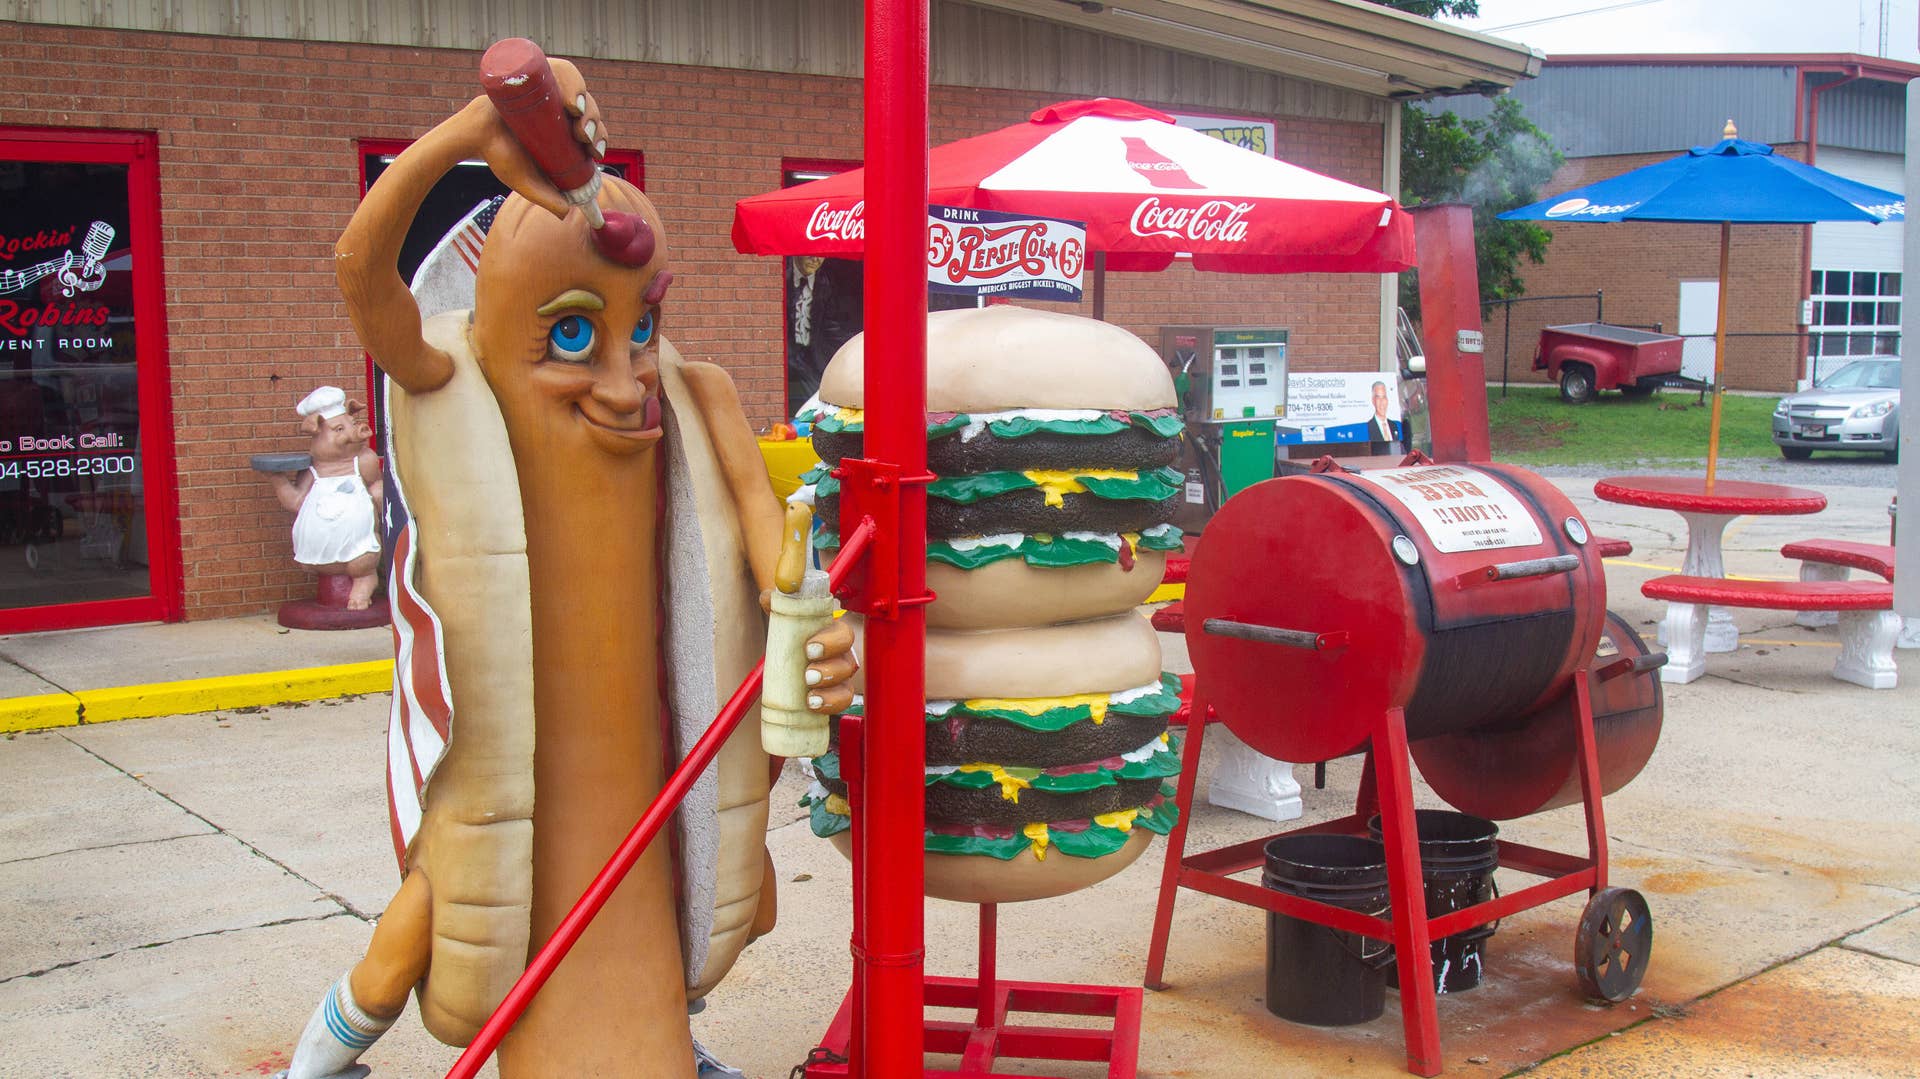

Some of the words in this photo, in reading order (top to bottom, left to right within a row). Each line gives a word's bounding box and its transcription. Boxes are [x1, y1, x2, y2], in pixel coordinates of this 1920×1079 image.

[806, 201, 865, 240] Coca-Co
[944, 208, 979, 222] DRINK
[1130, 197, 1255, 242] Coca-Cola
[1008, 280, 1032, 290] BIGGEST
[1055, 282, 1074, 294] WORTH
[0, 300, 109, 336] Robins
[0, 340, 45, 350] VENT
[59, 338, 113, 349] ROOM
[0, 440, 12, 452] o
[20, 434, 76, 451] Book
[79, 432, 123, 448] Call:
[0, 456, 134, 480] 4-528-2300
[1408, 480, 1488, 501] BBQ
